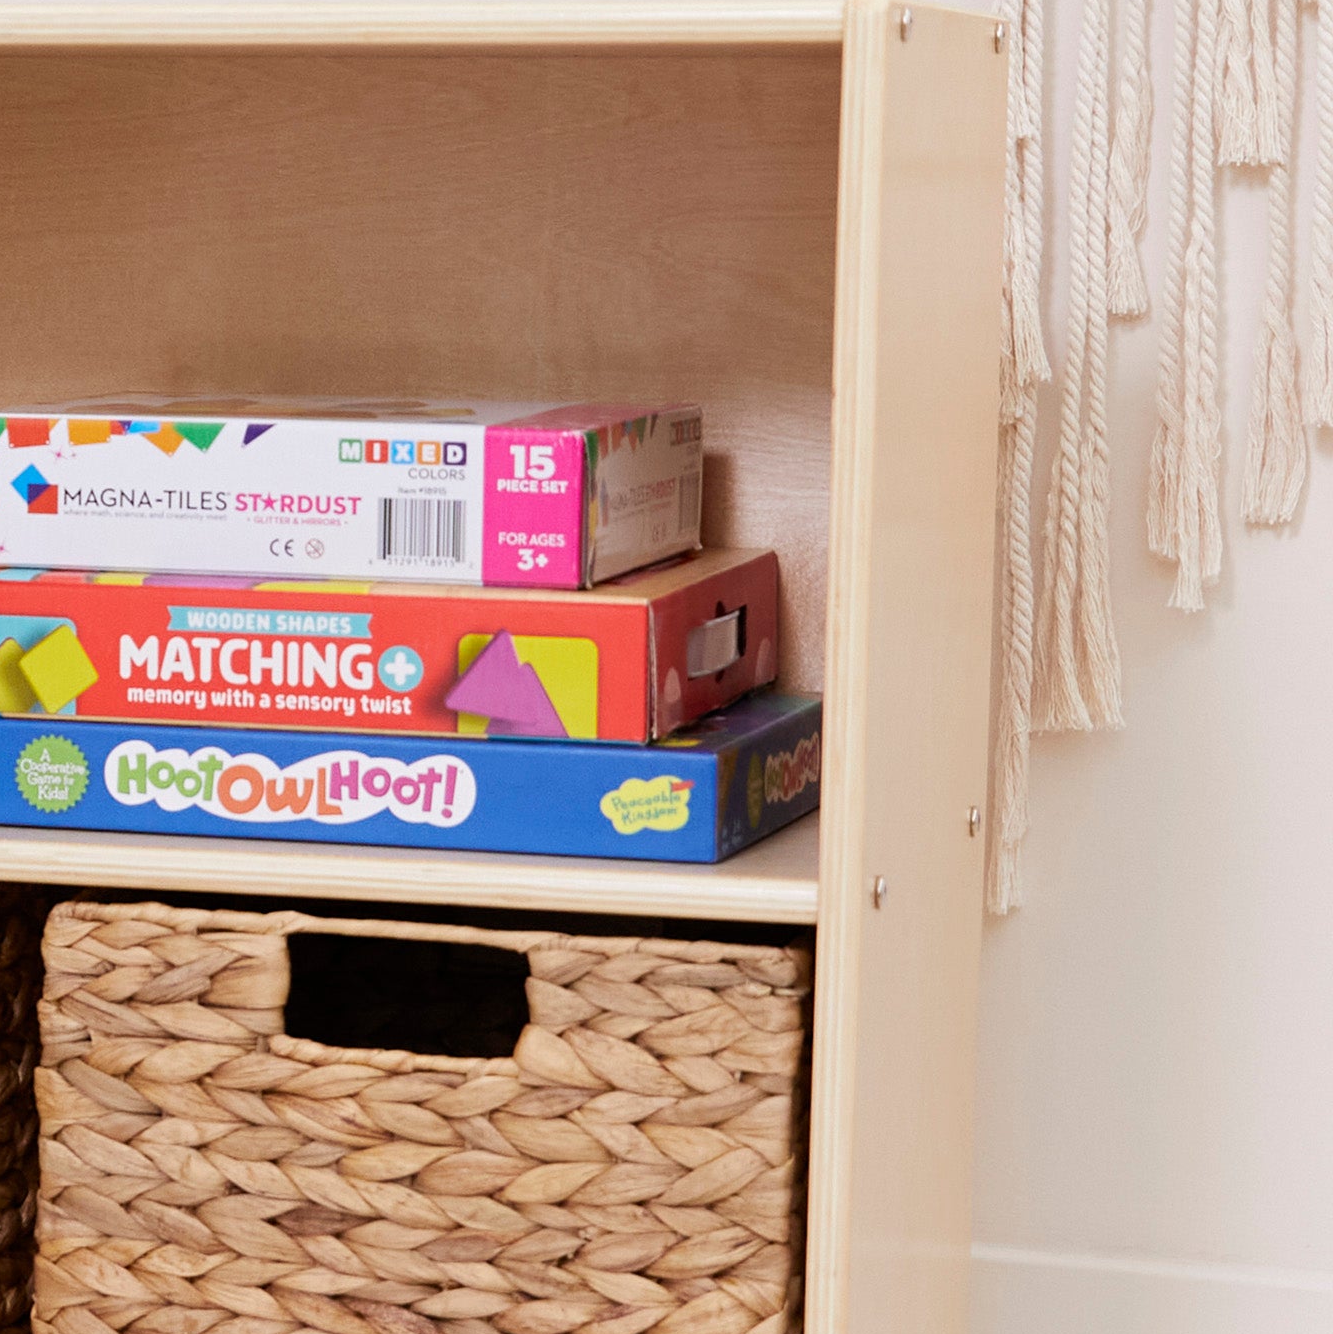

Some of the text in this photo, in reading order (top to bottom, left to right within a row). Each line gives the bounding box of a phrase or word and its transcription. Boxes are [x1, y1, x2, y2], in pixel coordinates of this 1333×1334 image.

[339, 439, 467, 465] MIXED
[509, 445, 556, 479] 15
[407, 467, 466, 481] COLORS
[496, 479, 569, 494] PIECE SET
[63, 488, 227, 511] MAGNA-TILES
[253, 516, 290, 525] GLITTER
[498, 532, 565, 547] FOR AGES
[517, 549, 549, 571] 3+
[186, 610, 351, 634] WOODEN SHAPES
[126, 687, 412, 717] memory with a sensory twist
[39, 748, 51, 762] A
[20, 758, 86, 775] Cooperative
[27, 772, 61, 785] Game
[38, 784, 69, 800] Kids!
[611, 791, 681, 811] Peaceable
[622, 808, 677, 824] Kingdom
